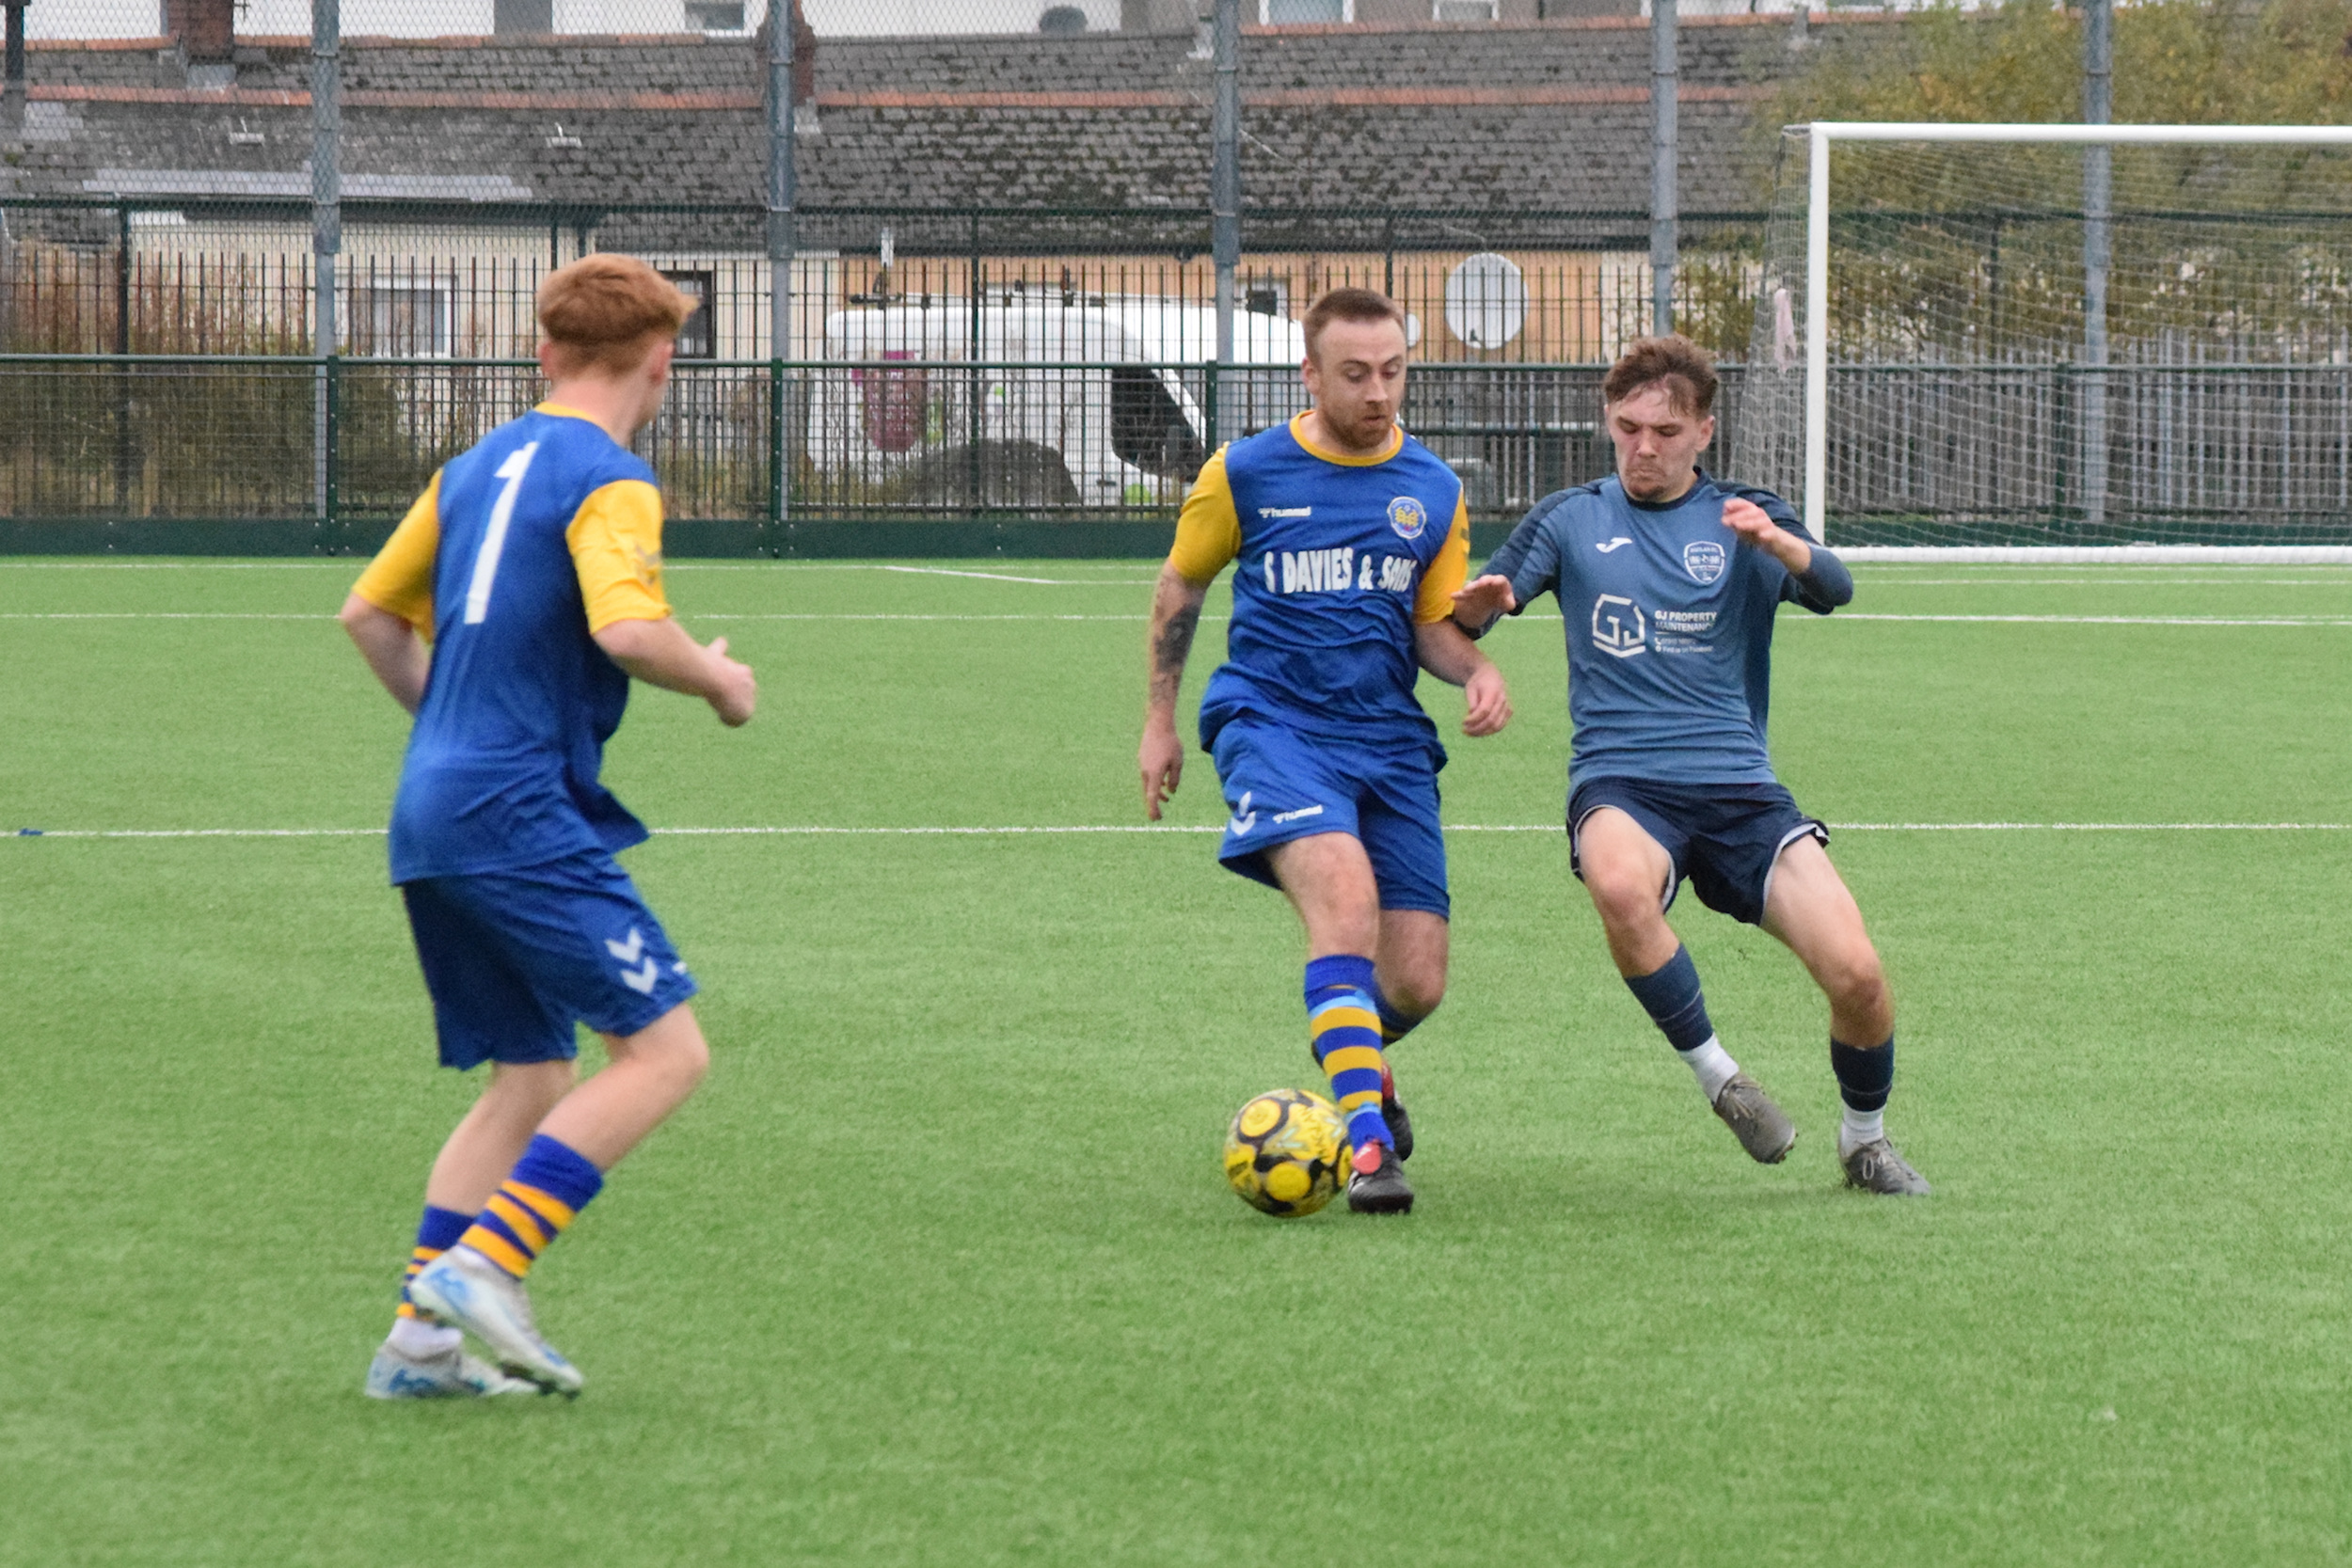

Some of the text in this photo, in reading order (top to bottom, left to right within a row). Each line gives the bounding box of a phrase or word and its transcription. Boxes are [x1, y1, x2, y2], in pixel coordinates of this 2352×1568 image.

[464, 442, 540, 624] 1
[1281, 546, 1354, 594] DAVIES
[1358, 554, 1374, 591] &
[1376, 554, 1418, 593] SONS
[1655, 610, 1717, 622] GJ PROPERTY
